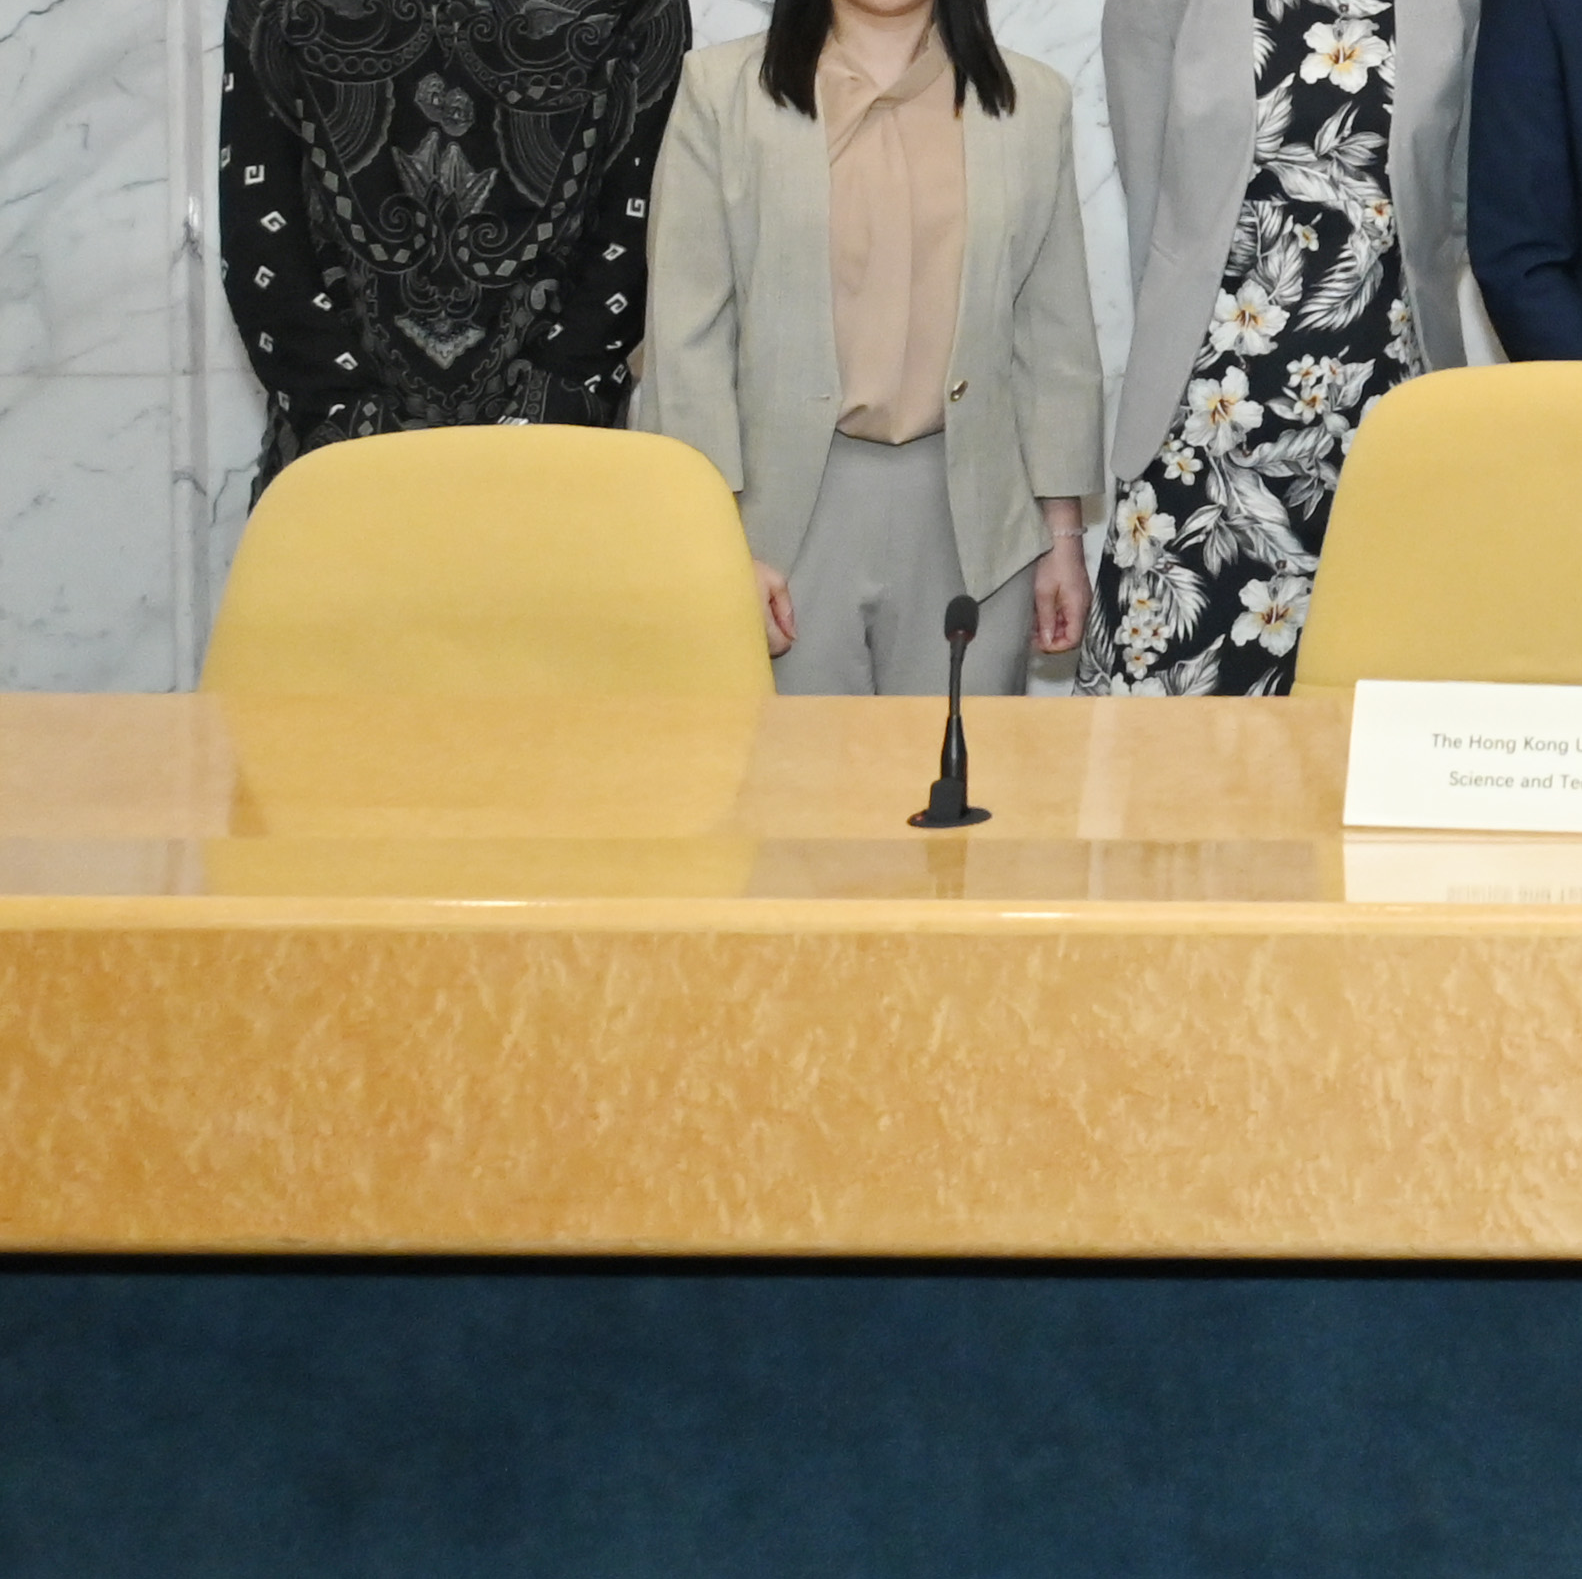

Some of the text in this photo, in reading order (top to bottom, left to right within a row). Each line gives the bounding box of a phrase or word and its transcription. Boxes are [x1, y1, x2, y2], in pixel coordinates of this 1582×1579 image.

[1431, 733, 1463, 749] The
[1468, 735, 1517, 754] Hong
[1523, 736, 1569, 756] Kong
[1449, 771, 1515, 788] Science
[1520, 774, 1554, 789] and
